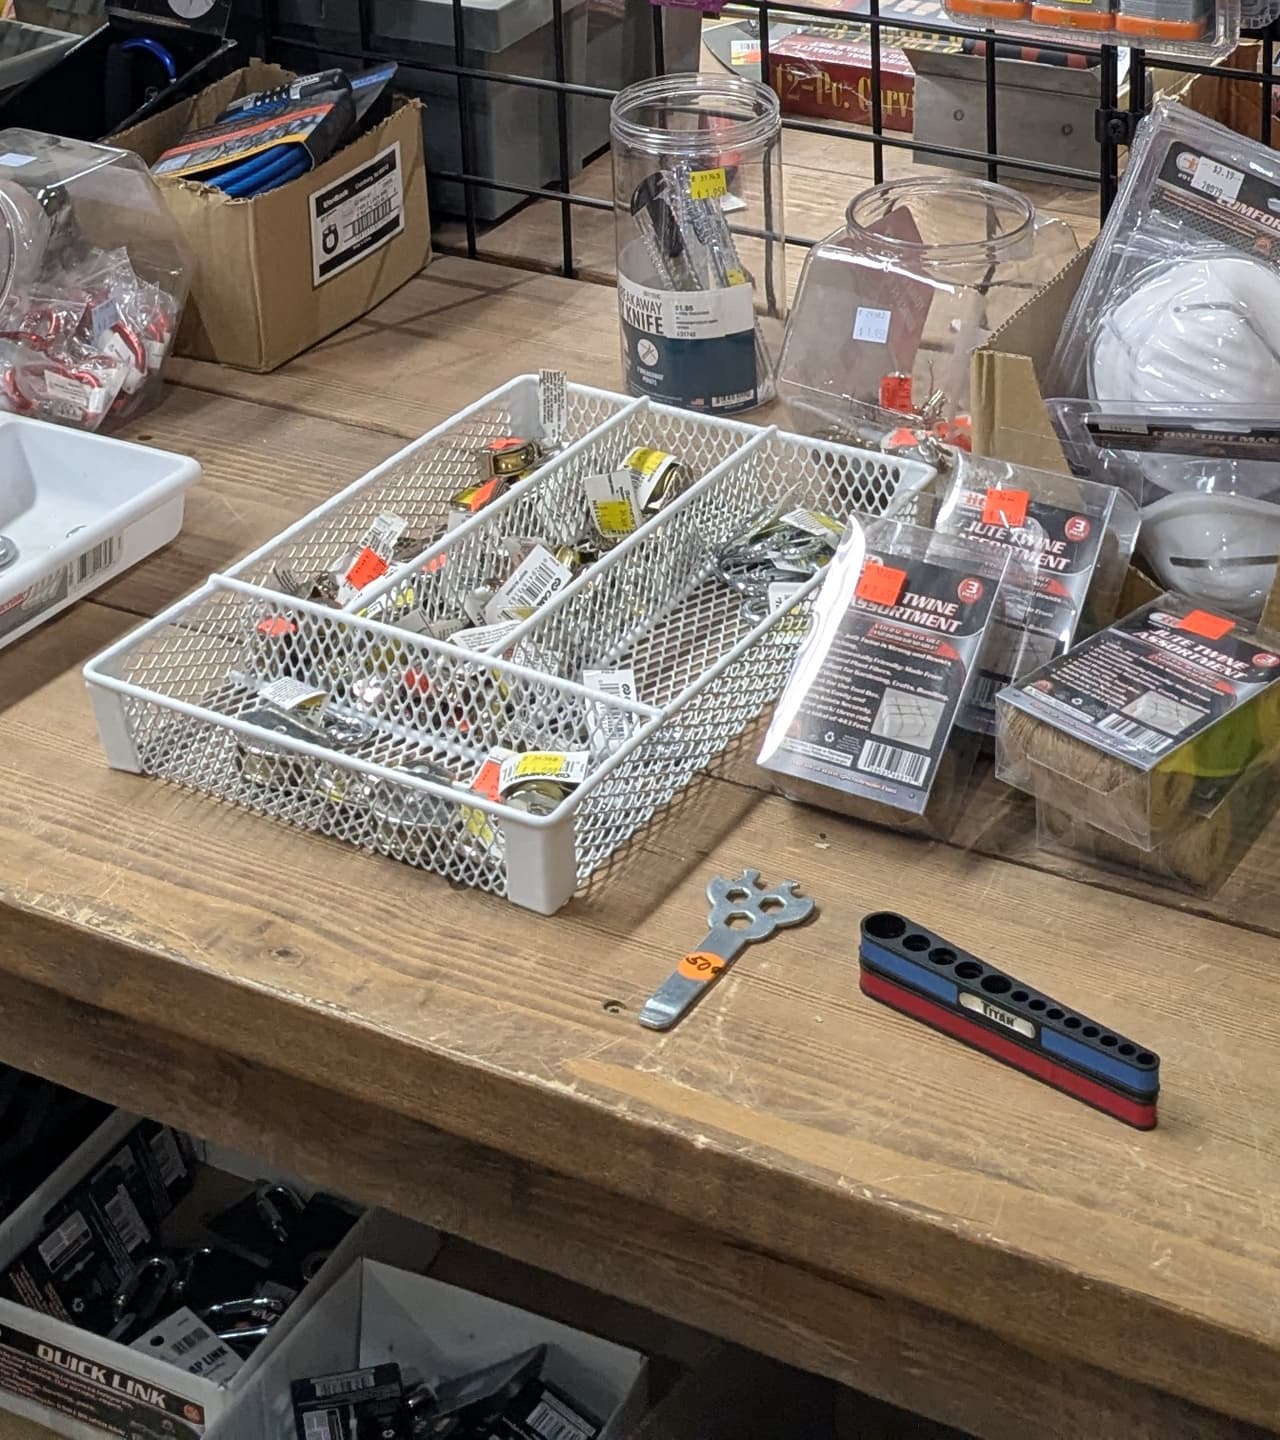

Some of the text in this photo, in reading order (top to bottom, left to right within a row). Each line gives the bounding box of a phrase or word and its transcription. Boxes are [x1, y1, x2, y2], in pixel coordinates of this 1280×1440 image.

[626, 306, 664, 335] KNIFE
[1153, 431, 1233, 445] COMFORT
[967, 521, 1008, 540] JUTE
[902, 592, 958, 616] TWINE
[1133, 631, 1248, 680] ASSORTMENT
[1148, 629, 1249, 670] JUTE TWINE
[980, 1000, 1017, 1027] TITAN
[36, 1342, 168, 1410] QUICK LINK
